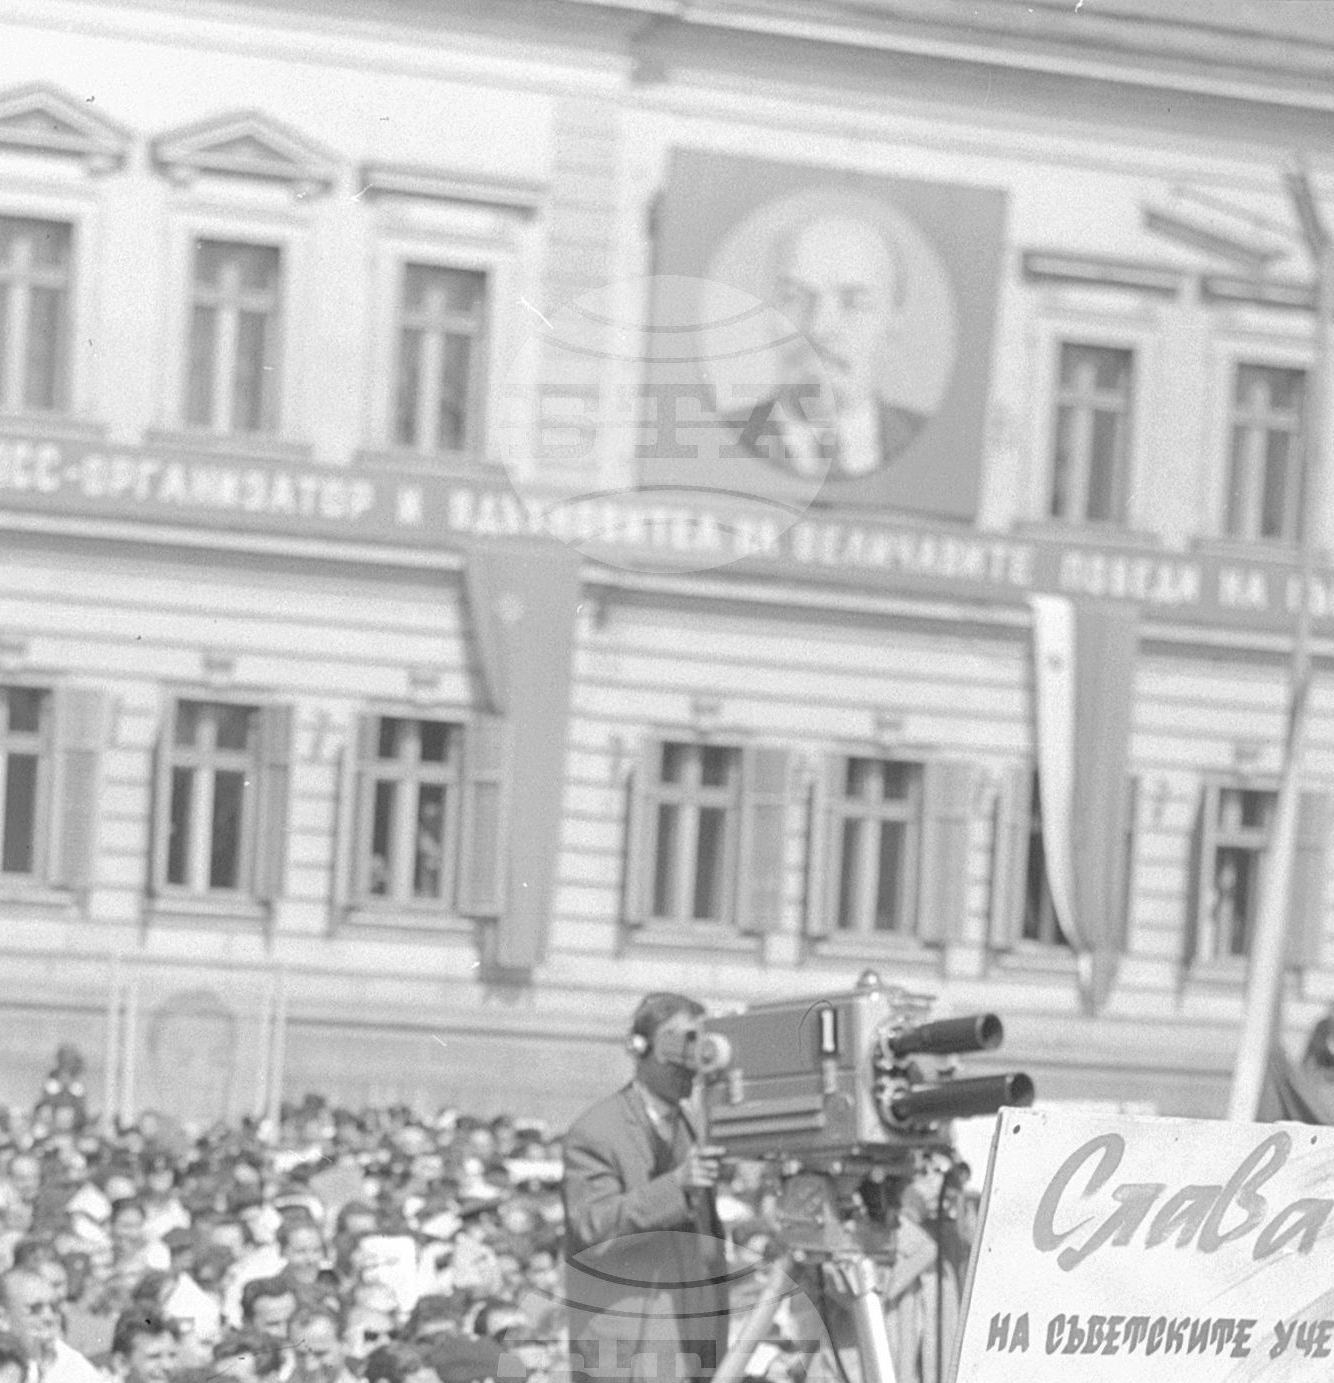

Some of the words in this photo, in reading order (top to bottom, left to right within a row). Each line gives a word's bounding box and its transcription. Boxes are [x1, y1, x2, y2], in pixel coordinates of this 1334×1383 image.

[395, 486, 422, 526] И
[734, 517, 780, 558] НА
[1058, 550, 1202, 605] ПОБЕДИ
[1218, 569, 1269, 609] НА
[986, 1312, 1030, 1355] НА
[1045, 1312, 1258, 1358] СЪВЕТСКИТЕ
